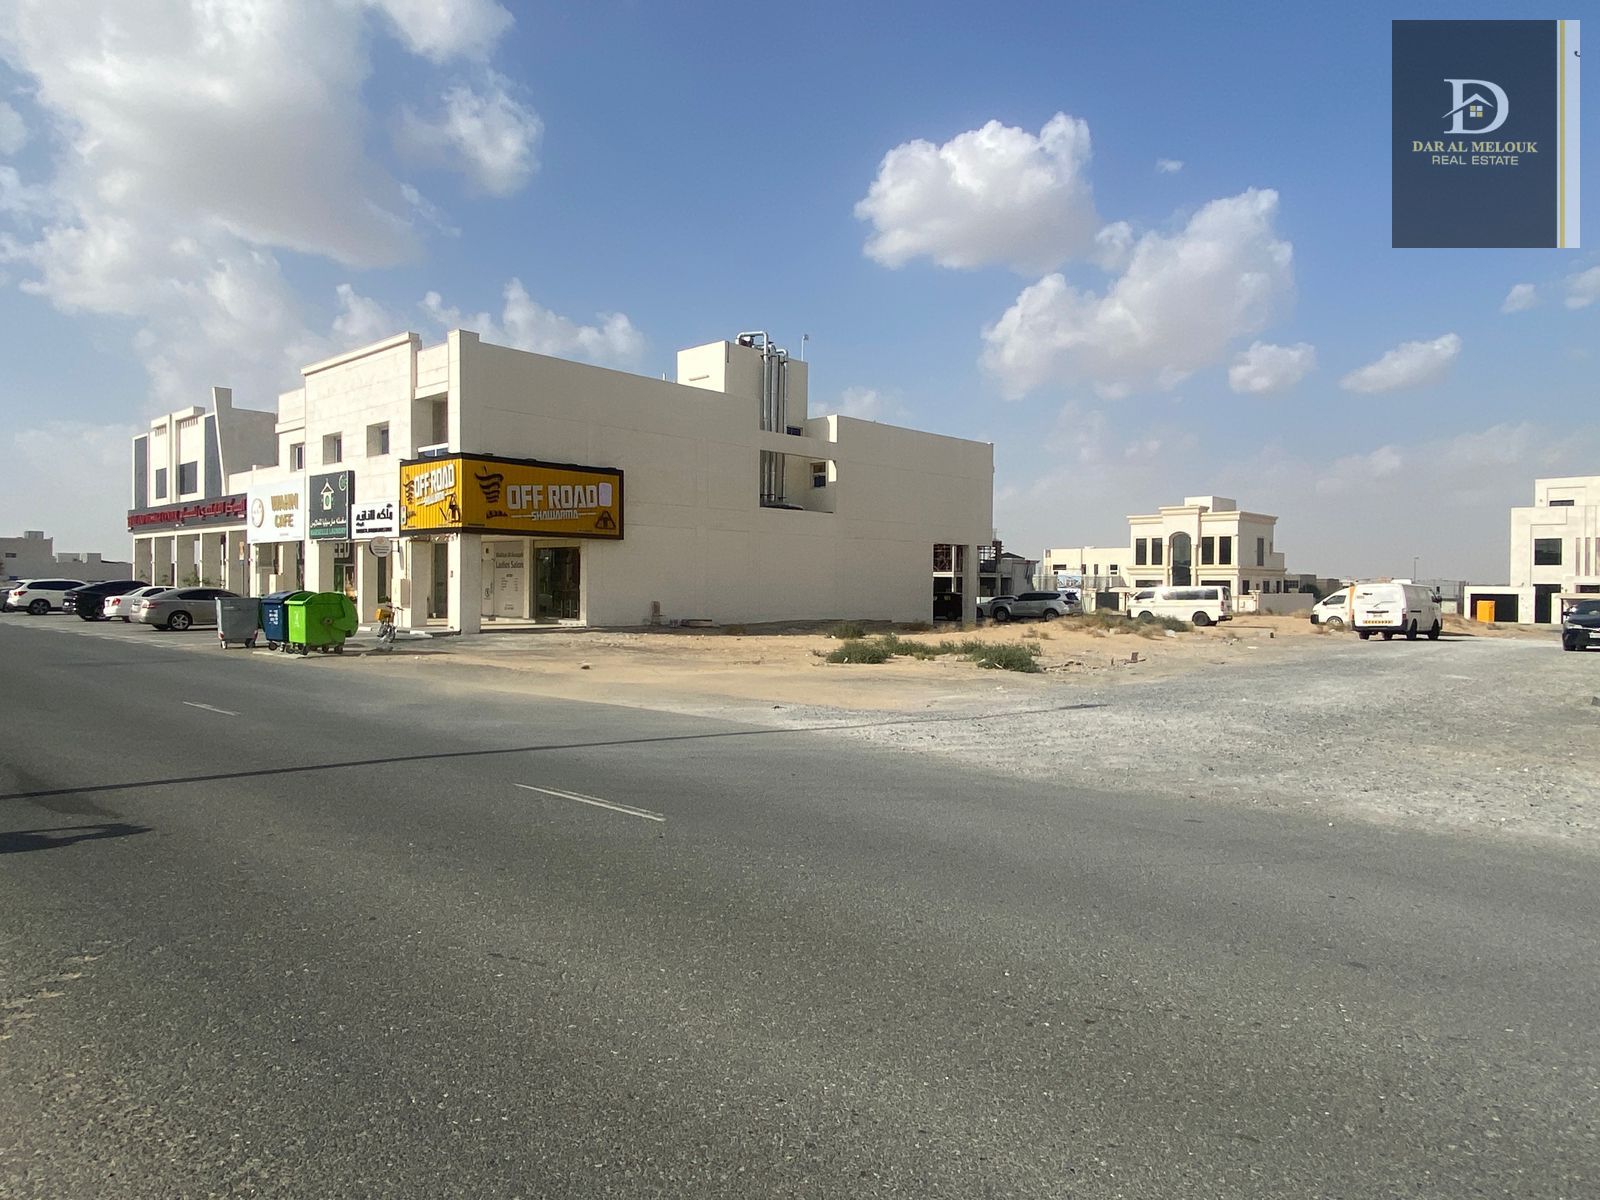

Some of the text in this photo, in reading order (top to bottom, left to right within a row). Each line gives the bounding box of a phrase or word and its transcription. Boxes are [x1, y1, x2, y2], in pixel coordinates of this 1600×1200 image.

[414, 463, 455, 498] OFF ROAD
[506, 485, 599, 510] OFF ROAD
